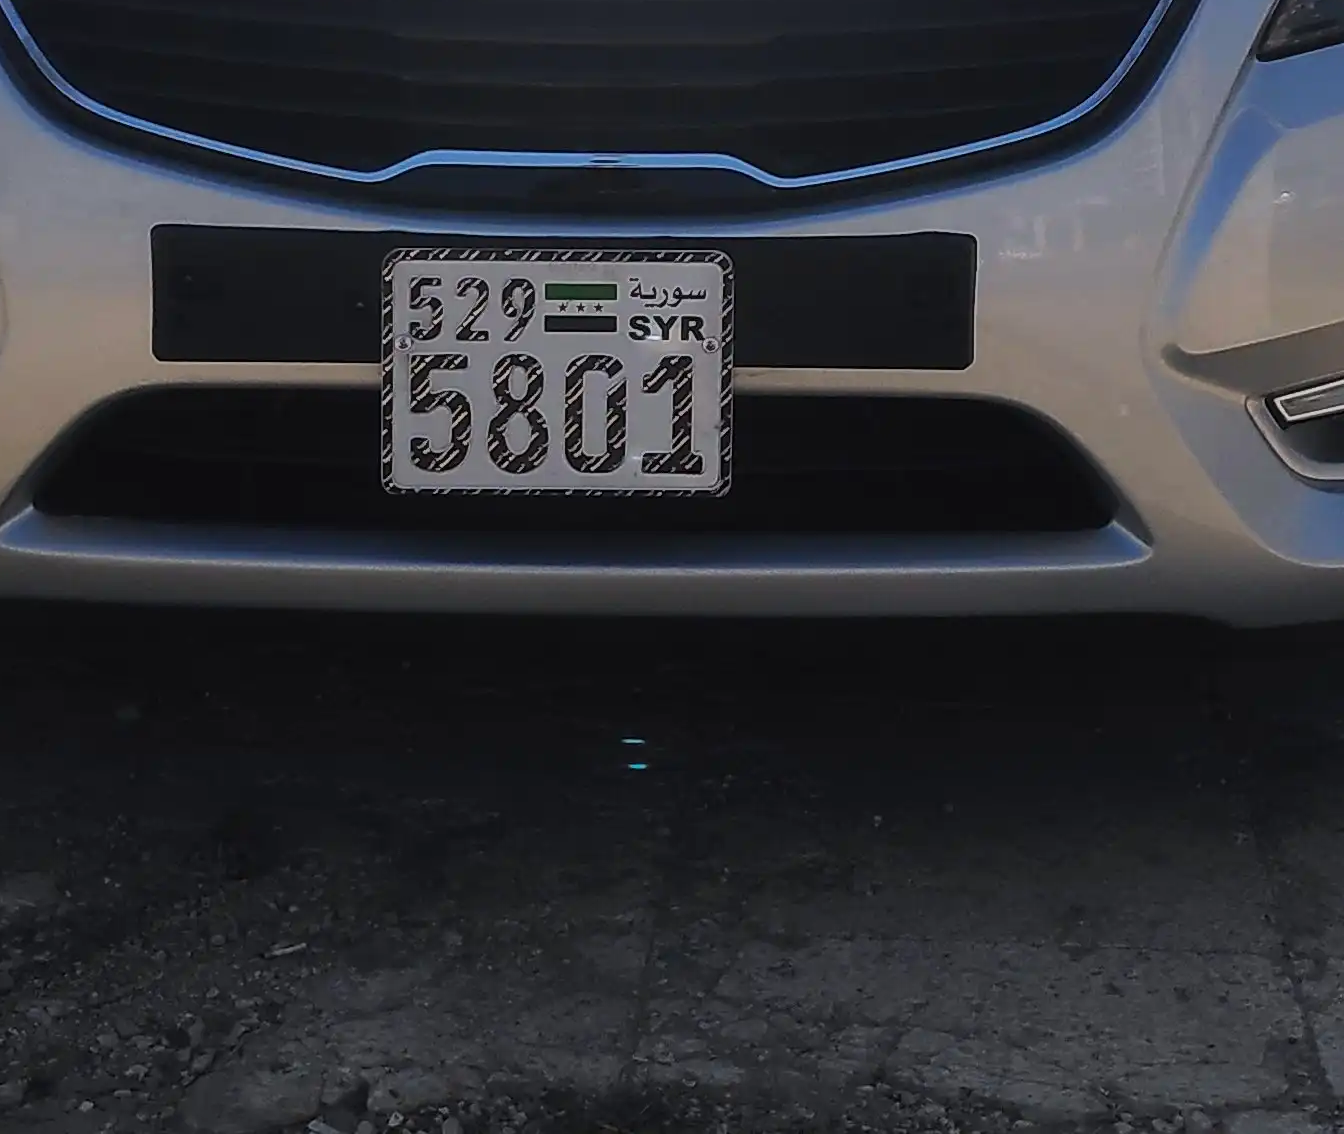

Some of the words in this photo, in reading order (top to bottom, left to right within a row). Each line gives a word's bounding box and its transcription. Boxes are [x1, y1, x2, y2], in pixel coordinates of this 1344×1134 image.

[409, 276, 536, 342] 529
[628, 277, 707, 308] سورية
[628, 315, 705, 342] SYR
[409, 353, 704, 475] 5801
